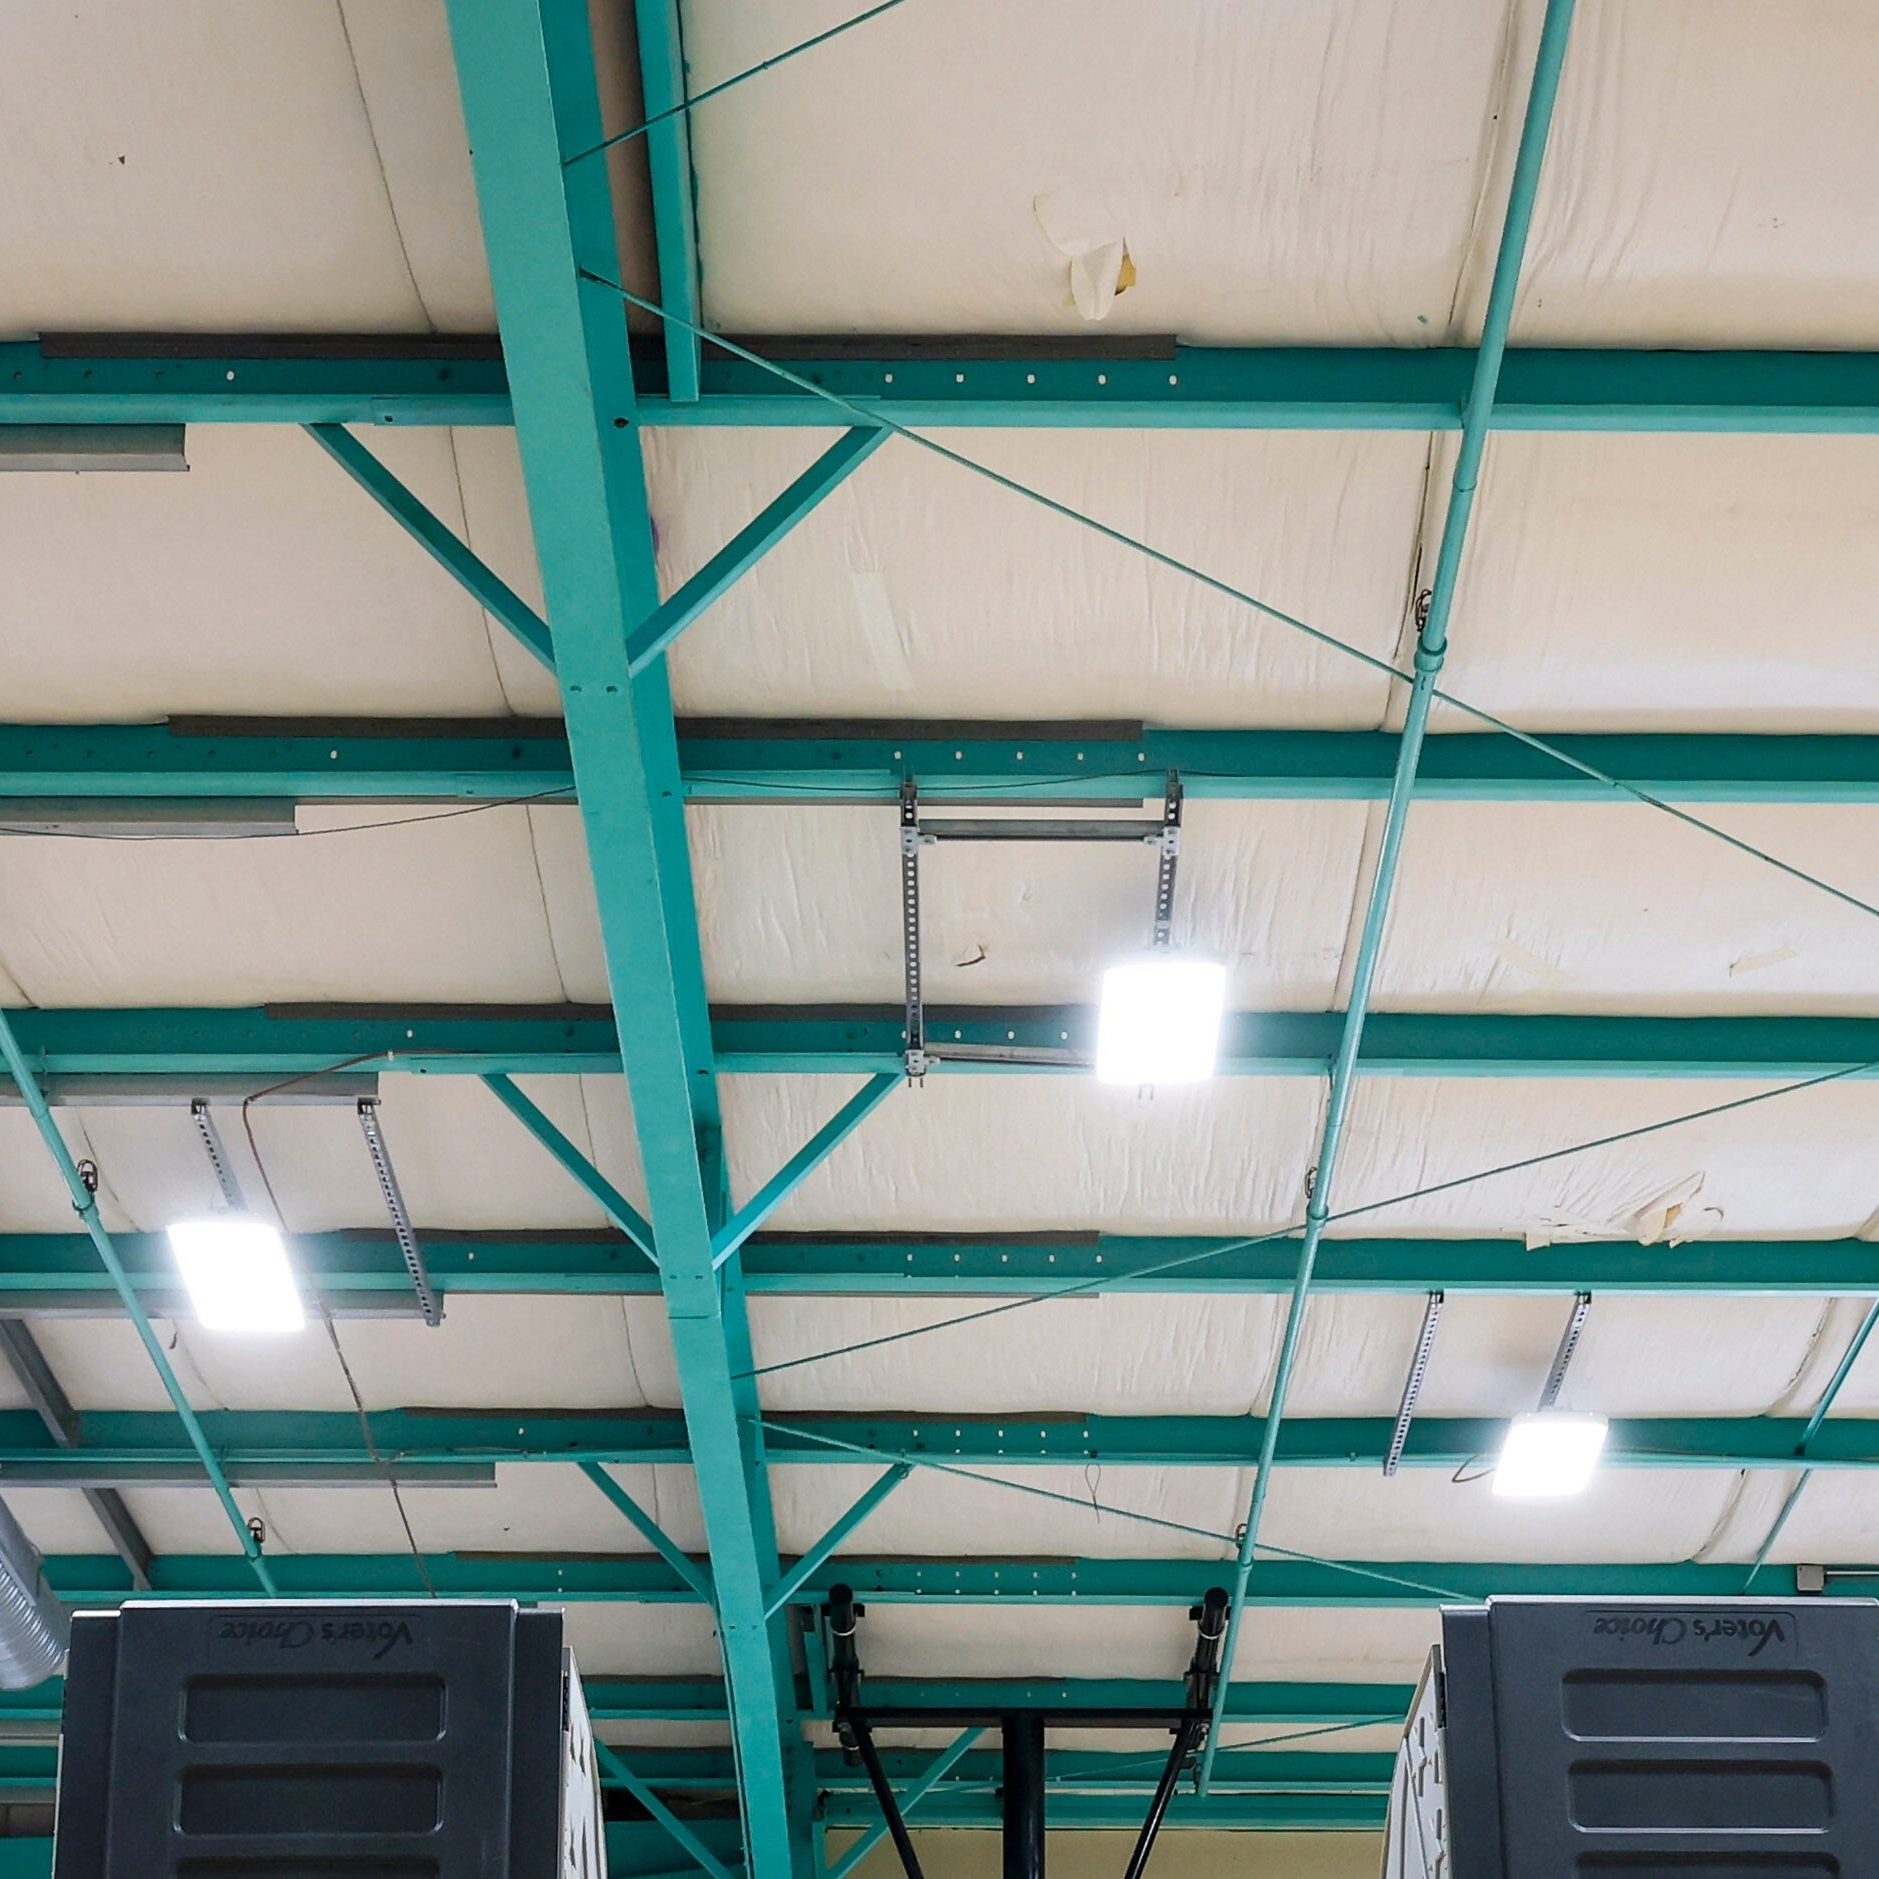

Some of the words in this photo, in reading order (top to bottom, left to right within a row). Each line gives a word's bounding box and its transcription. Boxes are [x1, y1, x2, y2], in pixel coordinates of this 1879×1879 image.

[220, 1621, 315, 1648] Choice
[322, 1621, 413, 1660] Voter's
[1593, 1617, 1687, 1645] Choice
[1693, 1617, 1785, 1657] Voter's
